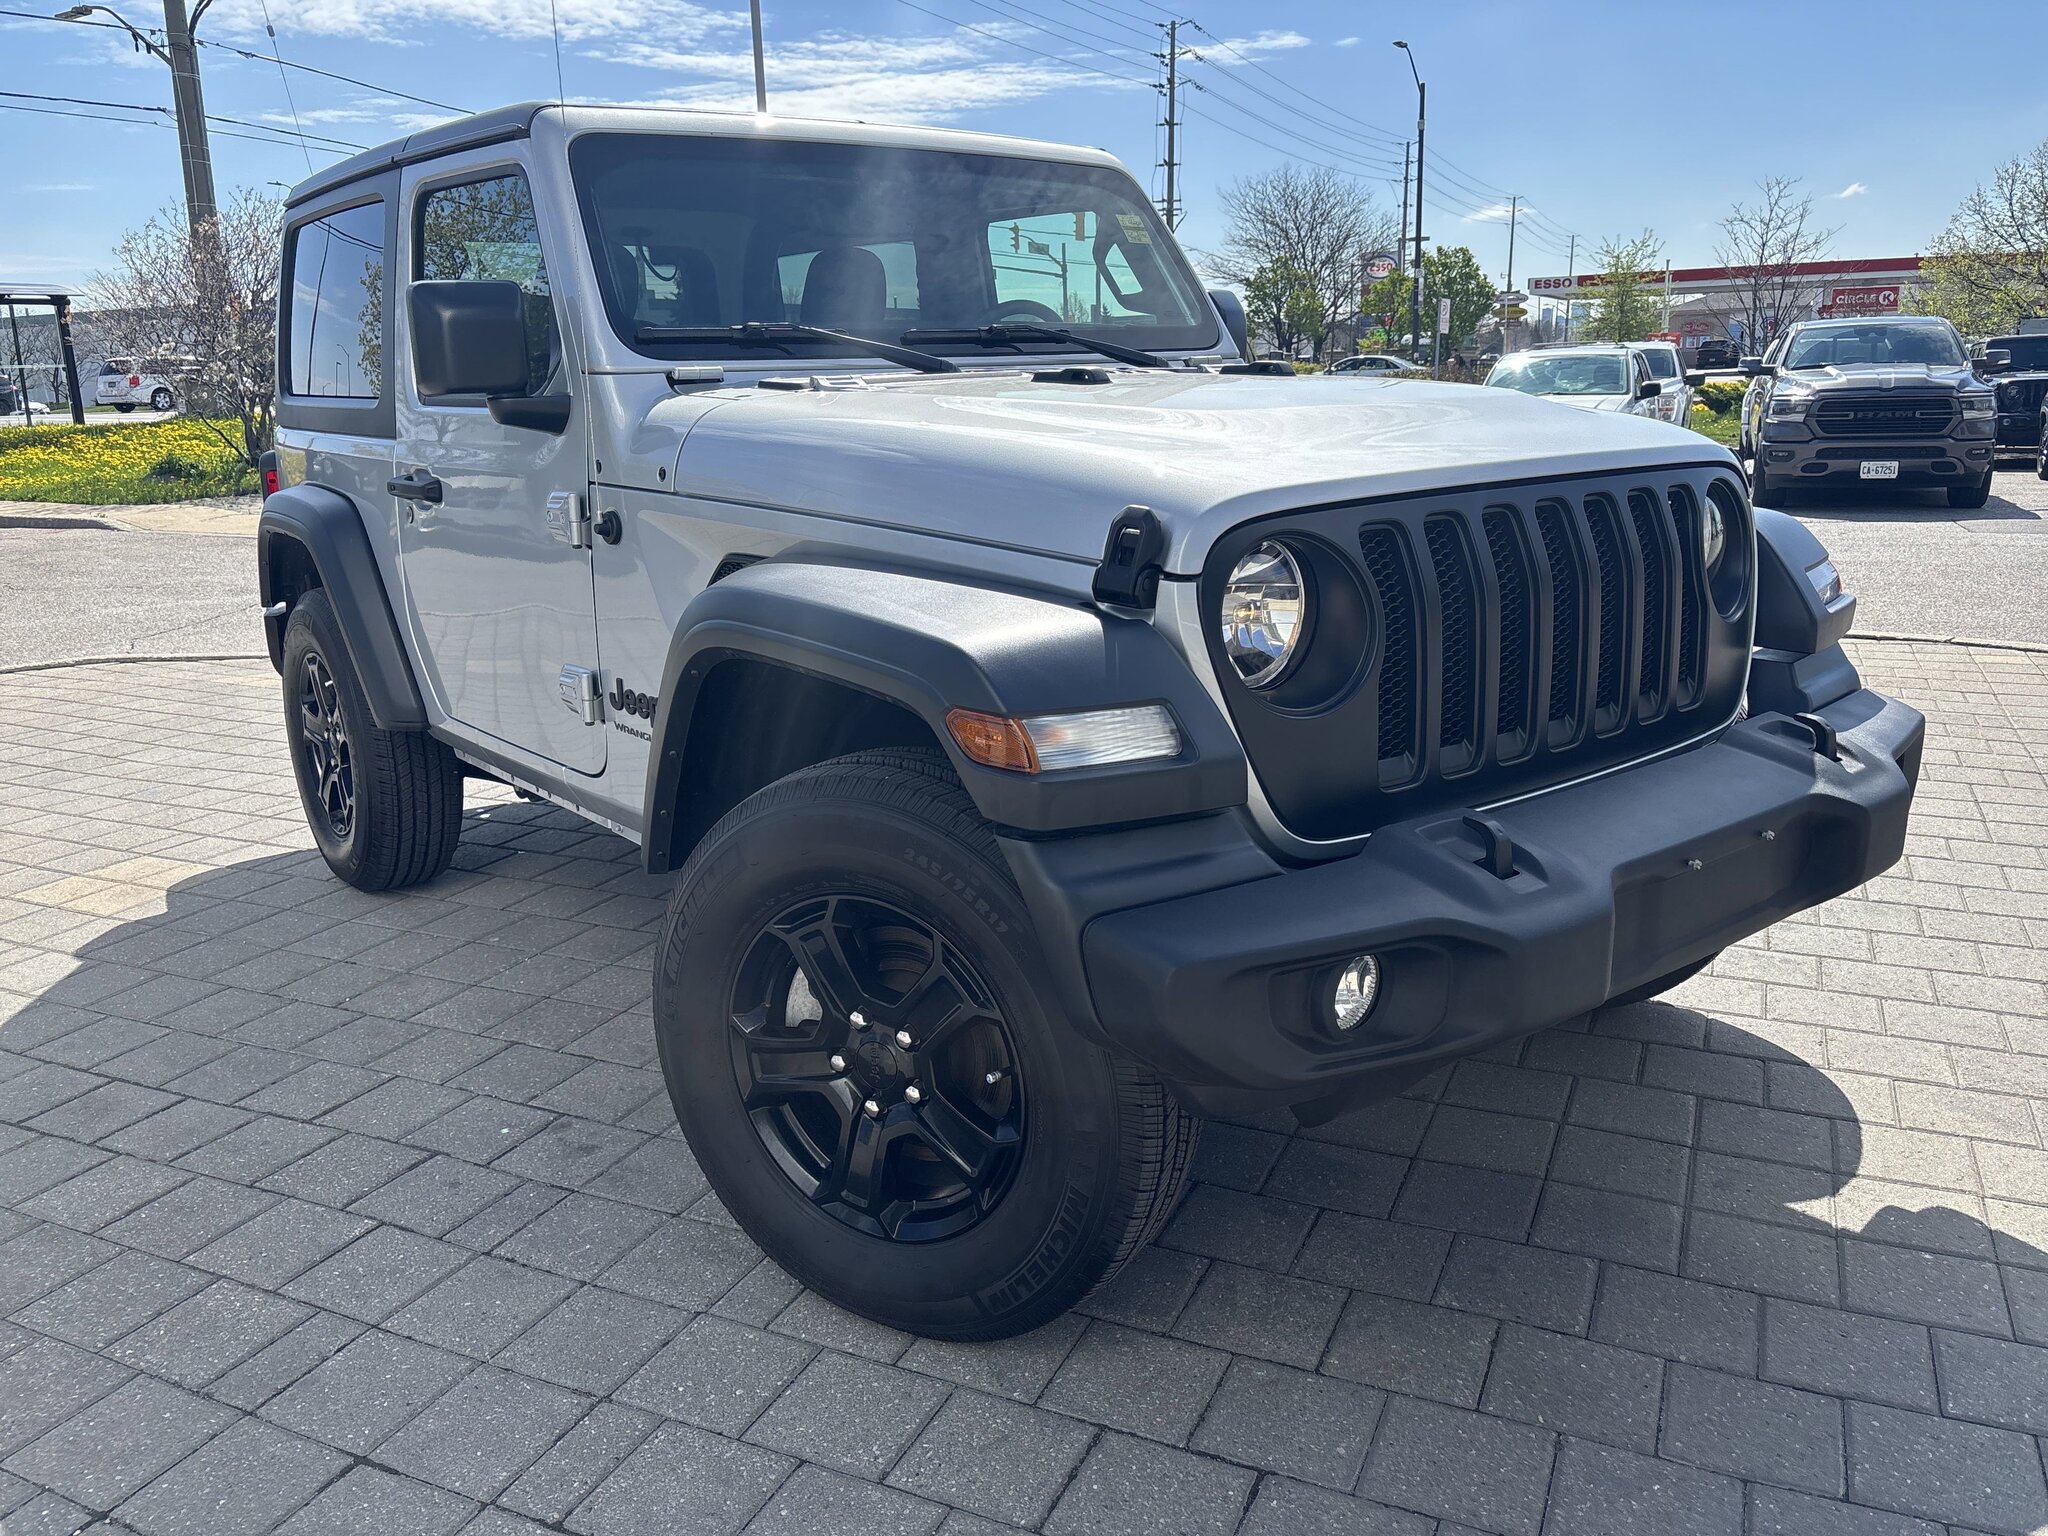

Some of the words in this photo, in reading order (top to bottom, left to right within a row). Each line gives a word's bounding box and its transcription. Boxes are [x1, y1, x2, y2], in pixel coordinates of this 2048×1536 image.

[1534, 278, 1572, 289] ESSO
[1835, 293, 1878, 305] CIRCLE
[1856, 410, 1914, 418] RAM
[980, 1182, 1091, 1315] MICHELIN
